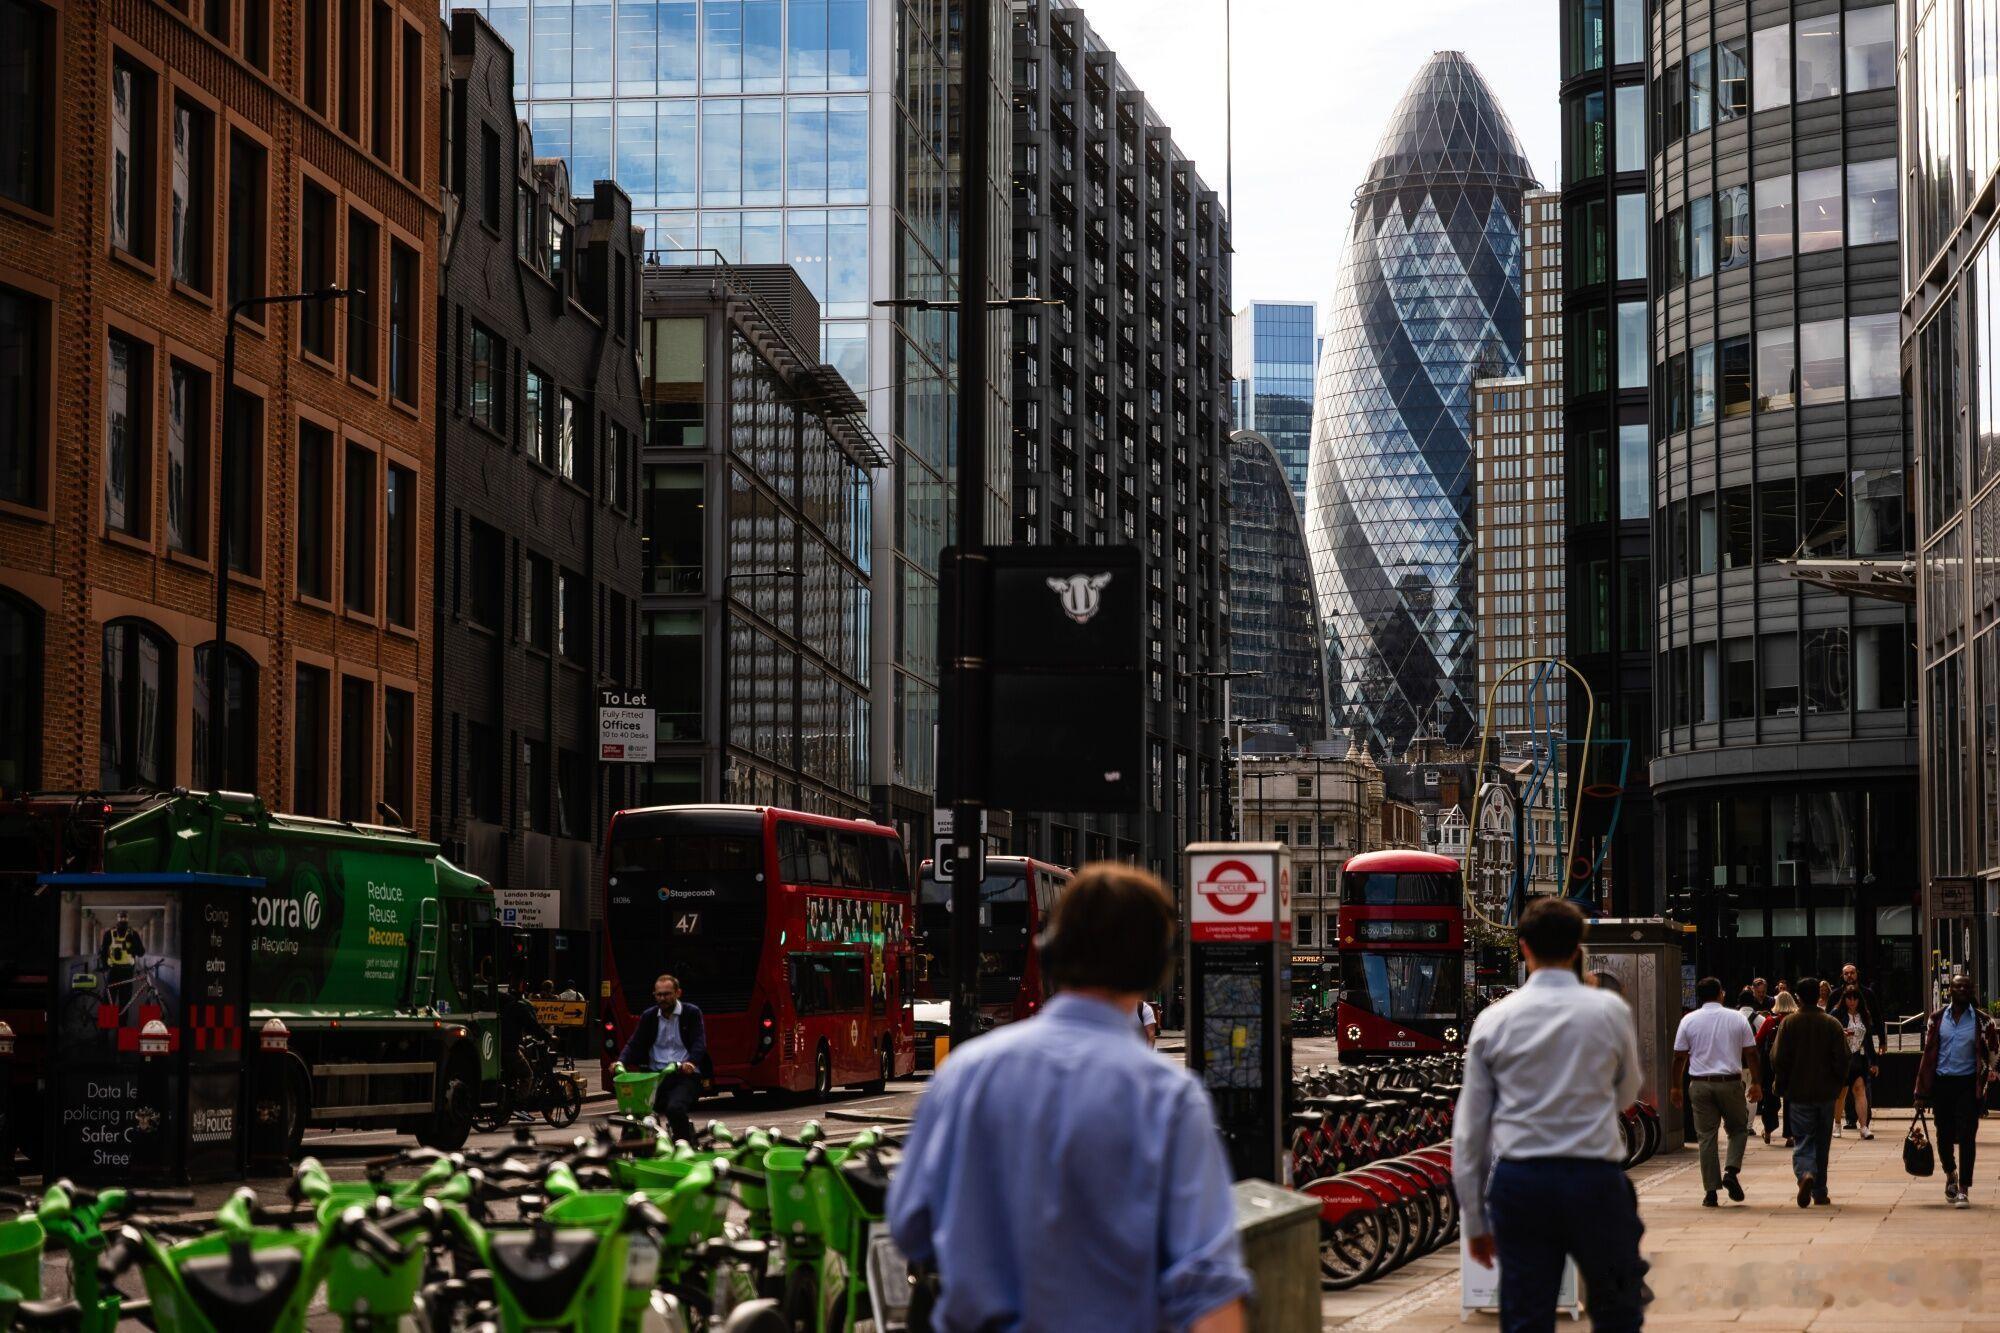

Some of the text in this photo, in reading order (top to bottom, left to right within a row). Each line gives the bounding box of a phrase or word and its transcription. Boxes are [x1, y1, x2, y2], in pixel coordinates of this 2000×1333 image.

[603, 692, 647, 706] To Let
[603, 711, 620, 719] Fully
[603, 720, 641, 730] Offices
[368, 881, 404, 901] Reduce.
[670, 889, 715, 898] Stagecoach
[204, 904, 229, 927] Going
[368, 904, 399, 924] Reuse.
[676, 914, 699, 933] 47
[1360, 924, 1437, 938] Bow Church 8
[210, 929, 222, 947] the
[368, 927, 407, 946] Recorra.
[261, 936, 299, 955] Recycling
[206, 959, 225, 973] extra
[207, 979, 223, 997] mile
[87, 1082, 121, 1098] Data
[64, 1104, 120, 1125] policing
[207, 1117, 232, 1132] POLICE
[81, 1125, 120, 1143] Safer
[93, 1149, 130, 1165] Stree
[1324, 1195, 1363, 1204] Santander
